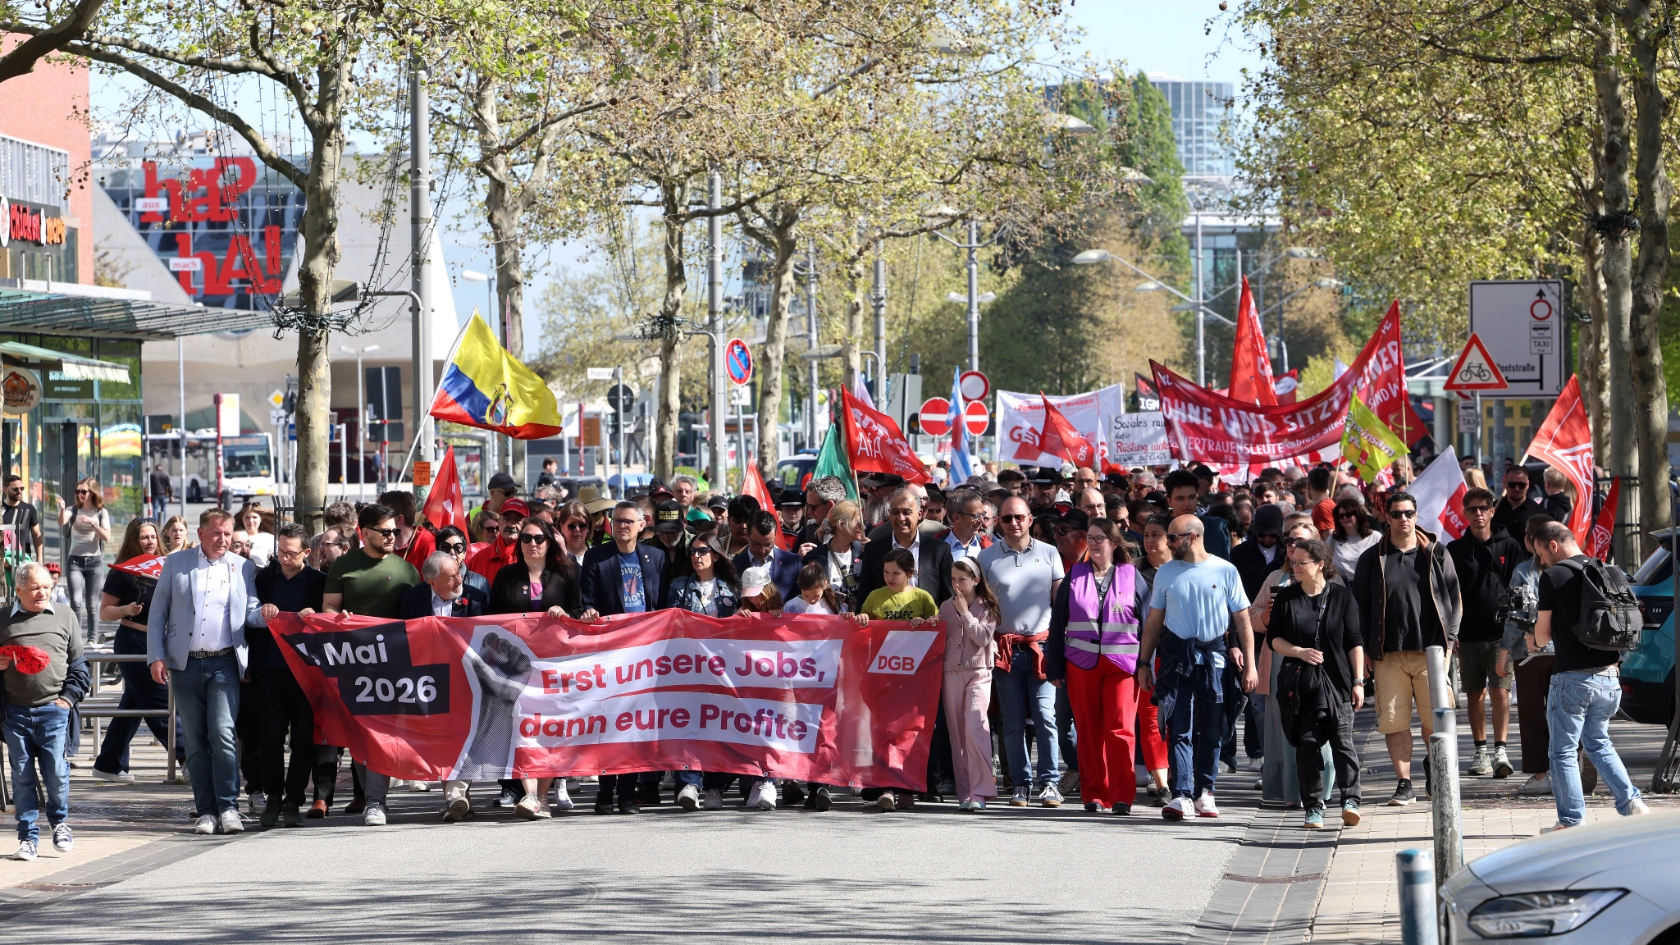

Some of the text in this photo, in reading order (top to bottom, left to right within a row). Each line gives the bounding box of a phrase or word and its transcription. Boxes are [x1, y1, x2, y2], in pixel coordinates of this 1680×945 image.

[142, 201, 161, 209] aus
[172, 260, 198, 270] mach
[1139, 397, 1160, 411] IGM
[1162, 396, 1214, 429] OHNE
[1219, 407, 1278, 437] UNS
[1283, 391, 1342, 433] SITZT
[1114, 416, 1165, 430] Soziales rau
[1182, 436, 1284, 456] VERTRAUENSLEUTE
[1368, 387, 1390, 411] SIND
[1462, 418, 1476, 426] TAX
[857, 431, 884, 460] AfA
[1115, 441, 1148, 454] Rüstung
[323, 634, 388, 666] Mai
[541, 650, 826, 695] Erst unsere Jobs,
[877, 655, 915, 671] DGB
[354, 675, 437, 704] 2026
[519, 703, 808, 742] dann eure Profite
